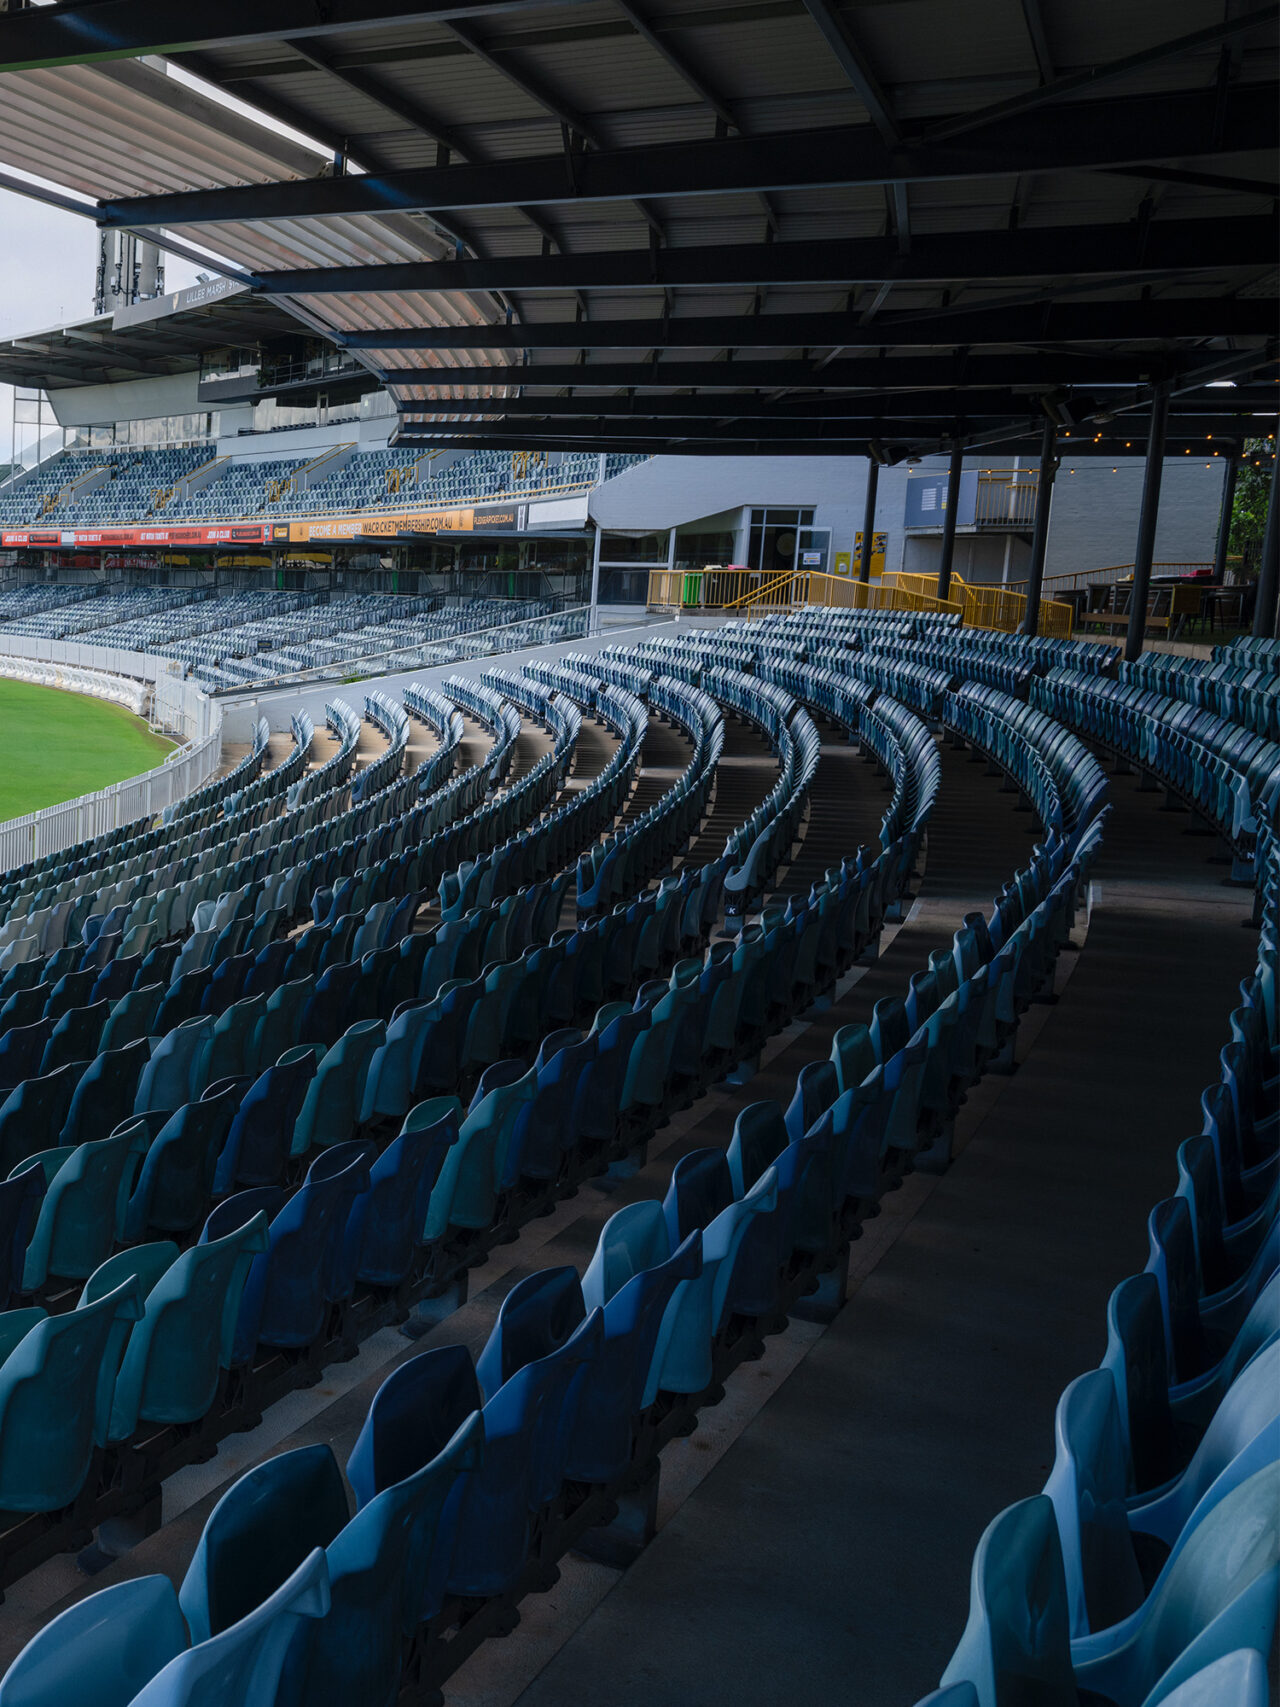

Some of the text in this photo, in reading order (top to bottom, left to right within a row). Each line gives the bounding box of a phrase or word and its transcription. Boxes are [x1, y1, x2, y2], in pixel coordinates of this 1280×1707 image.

[186, 289, 204, 303] LILLEE
[207, 282, 226, 296] MARSH
[309, 525, 331, 536] BECOME
[332, 525, 337, 535] A
[338, 523, 362, 536] MEMBER
